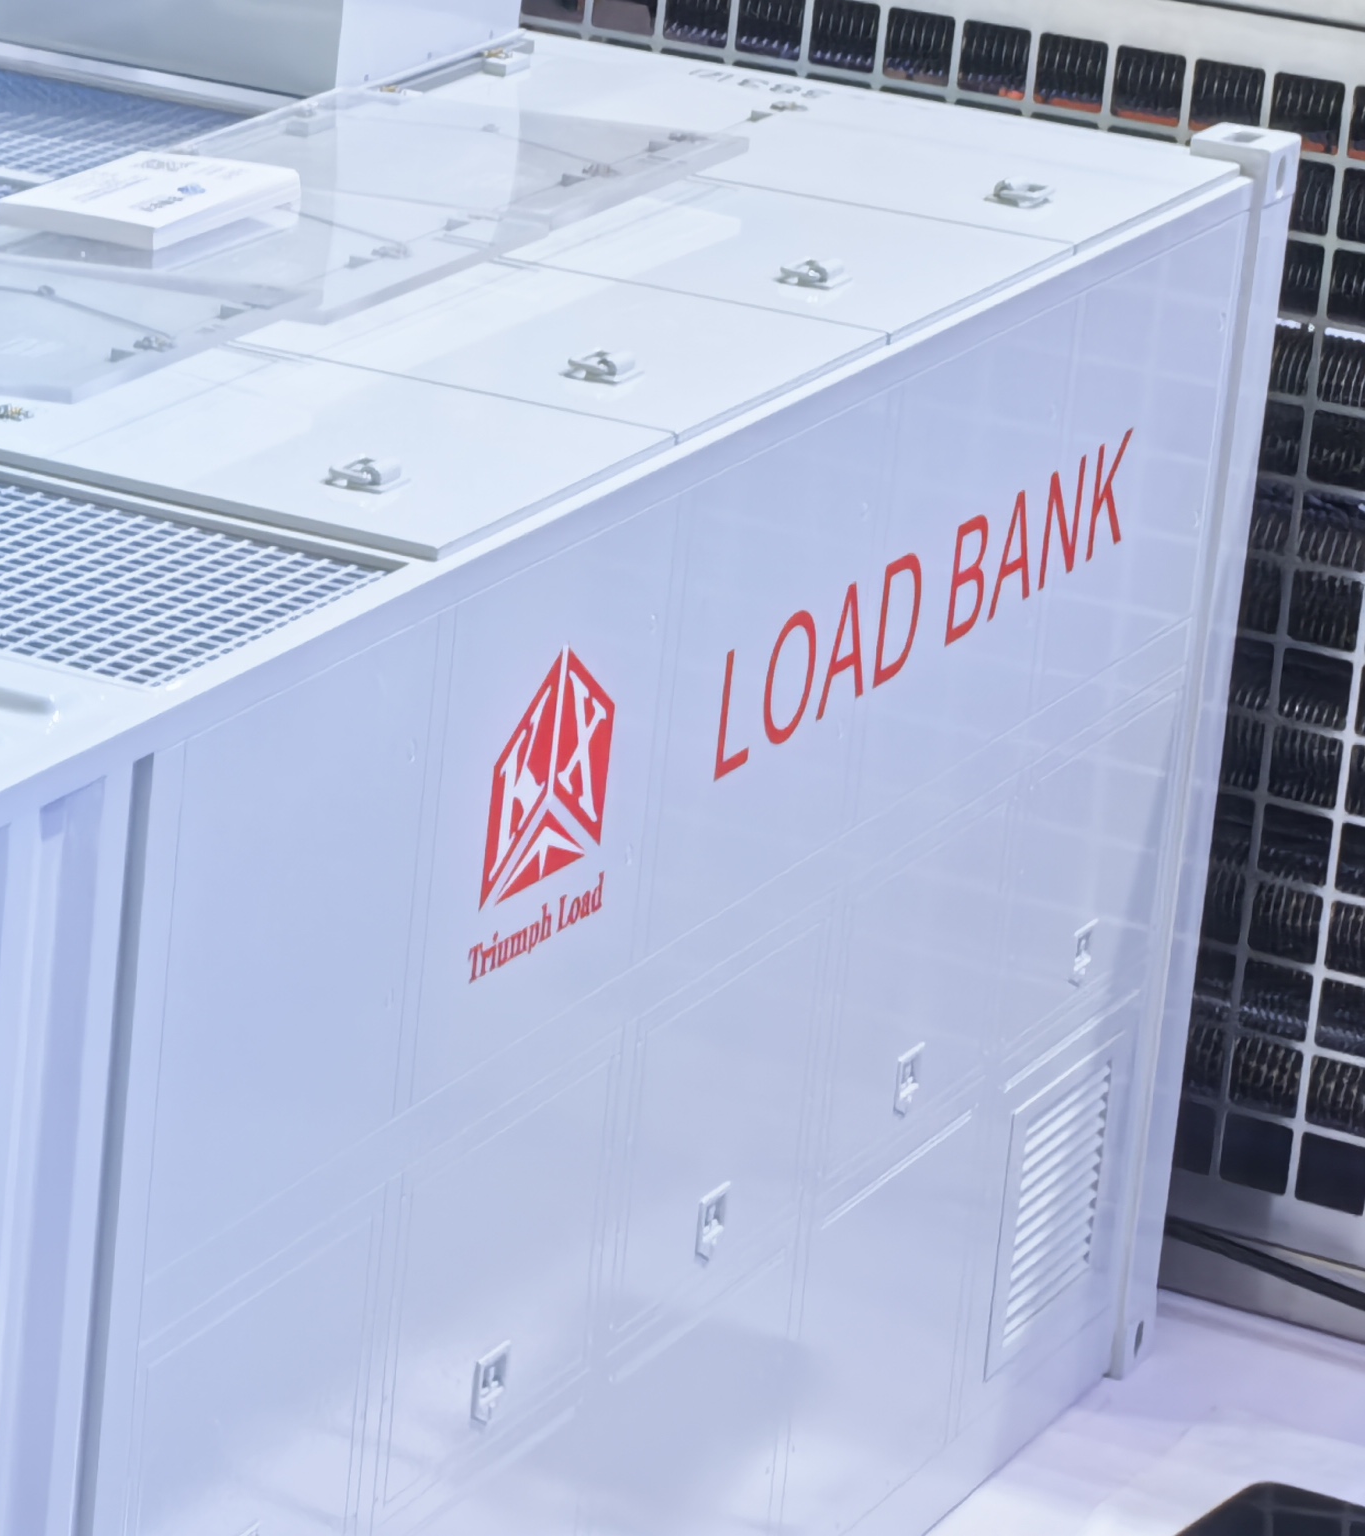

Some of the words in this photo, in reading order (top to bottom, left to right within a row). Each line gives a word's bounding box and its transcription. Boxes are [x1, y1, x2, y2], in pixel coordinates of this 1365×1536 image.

[713, 552, 923, 783] LOAD
[943, 426, 1135, 648] BANK
[468, 901, 553, 985] Triumph
[556, 870, 605, 934] Load
